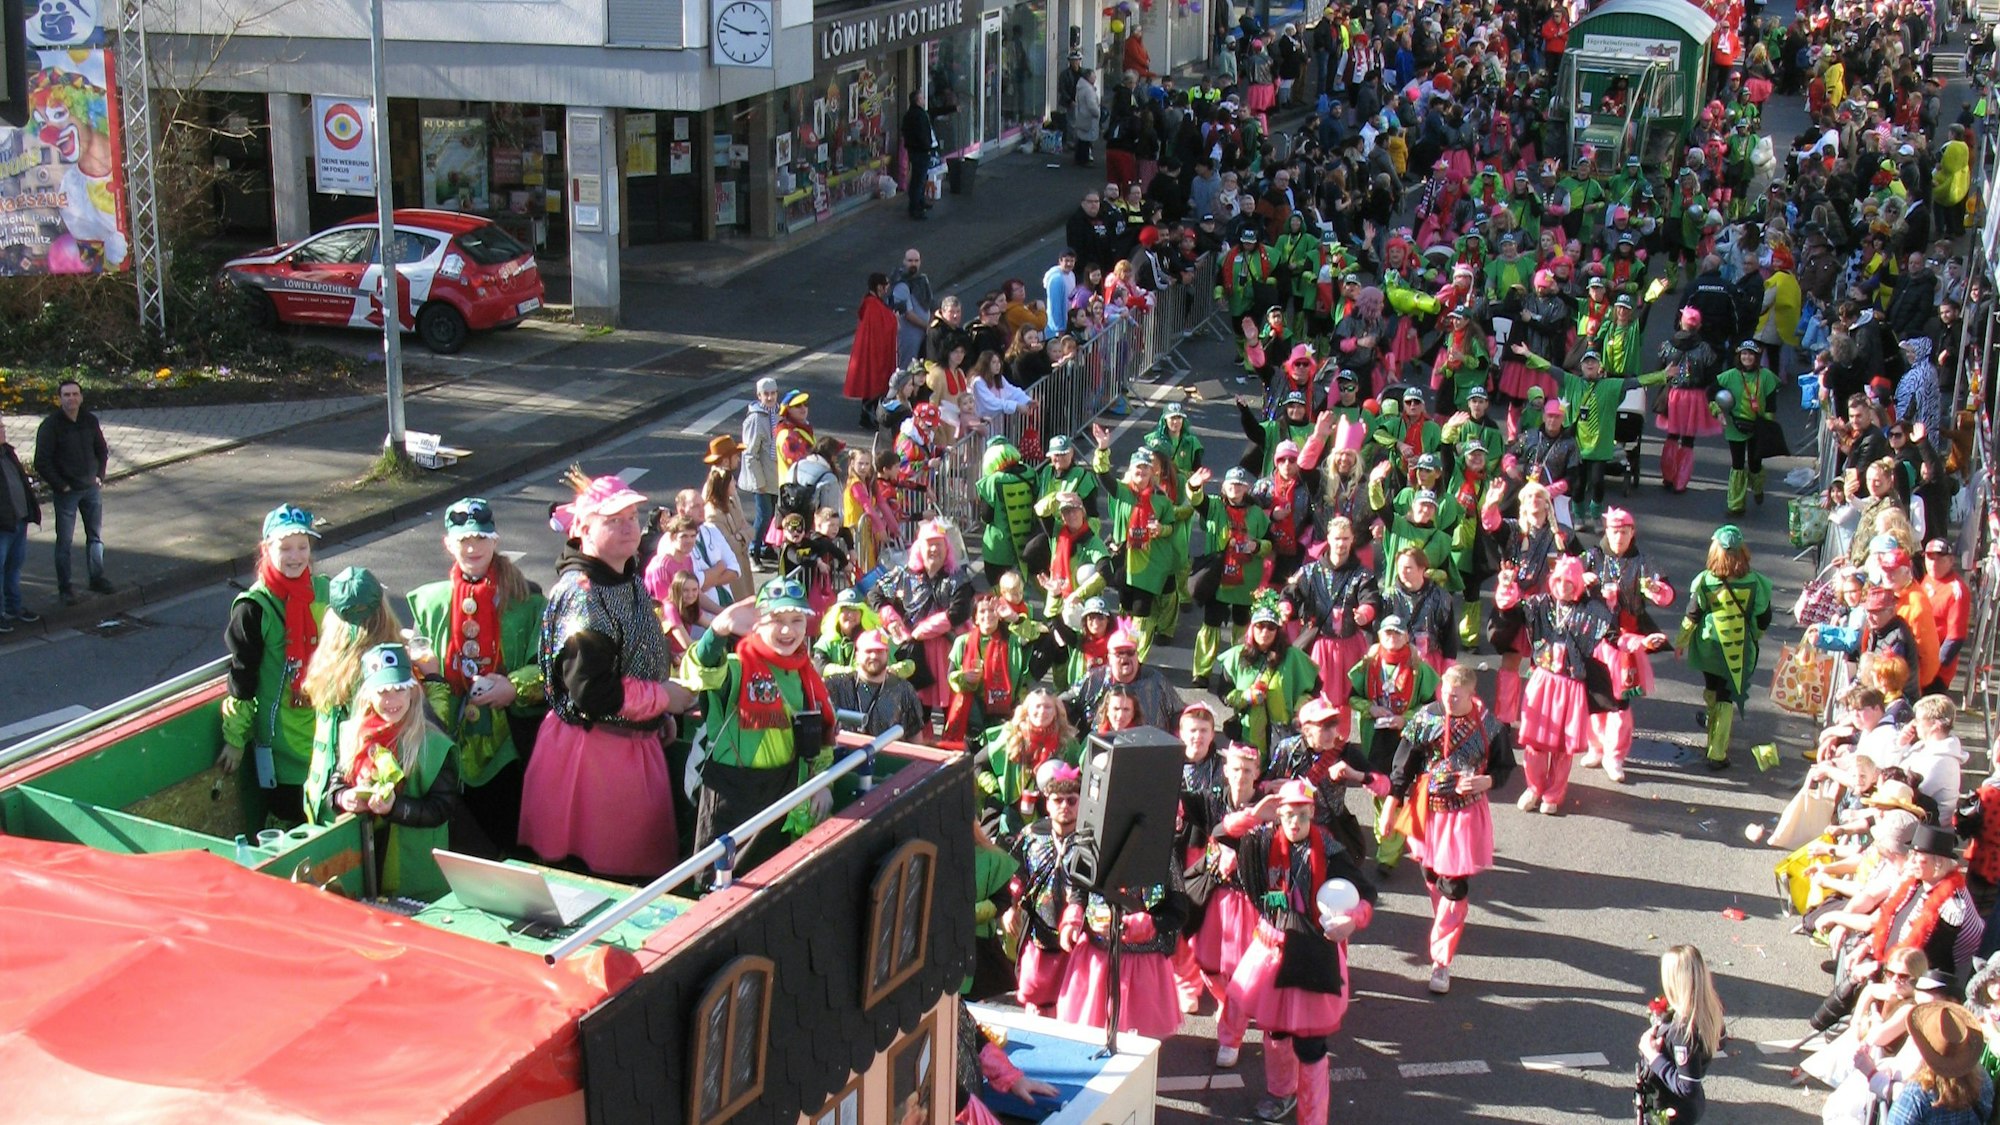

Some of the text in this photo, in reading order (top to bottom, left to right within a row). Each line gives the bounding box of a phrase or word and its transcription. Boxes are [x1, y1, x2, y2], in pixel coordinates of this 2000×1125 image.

[822, 0, 963, 60] LÖWEN-APOTHEKE
[423, 119, 466, 128] NUXE
[339, 159, 370, 167] WERBUNG
[33, 214, 62, 226] Party
[312, 282, 353, 295] APOTHEKE
